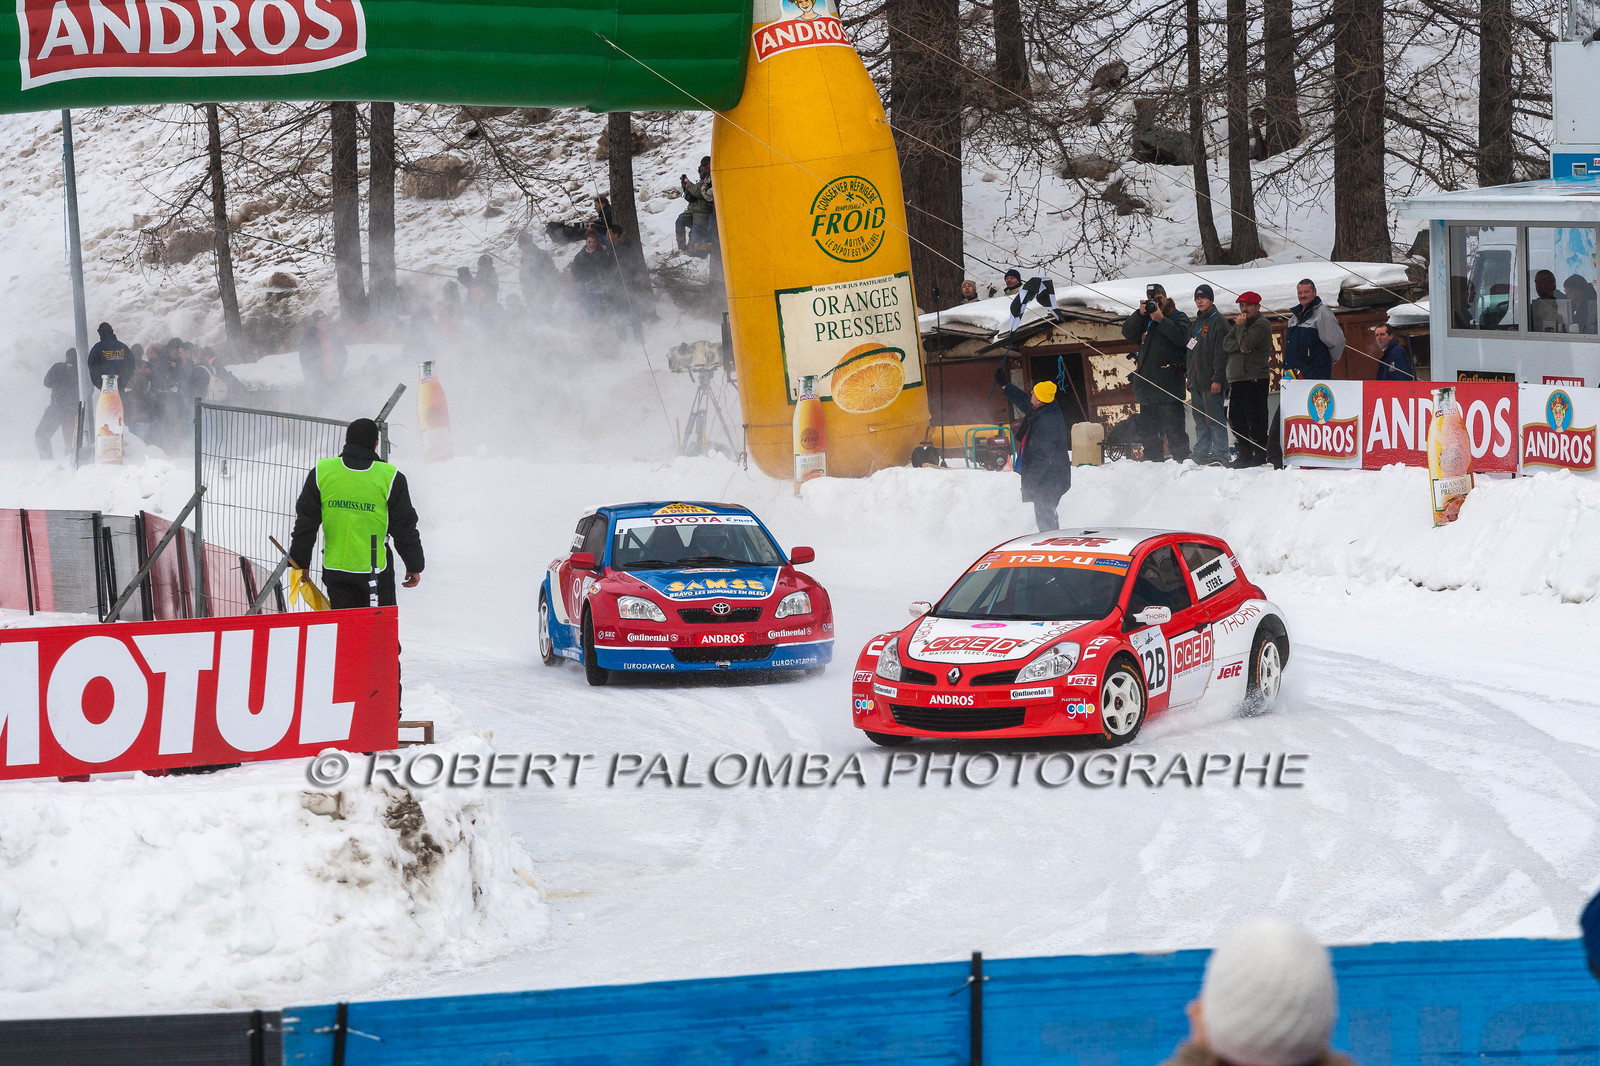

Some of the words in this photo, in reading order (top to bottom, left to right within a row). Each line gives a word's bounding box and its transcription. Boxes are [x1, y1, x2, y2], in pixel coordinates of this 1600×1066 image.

[37, 0, 344, 61] ANDROS
[761, 20, 849, 54] ANDROS
[817, 181, 849, 211] CONSERVER
[811, 206, 886, 237] FROID
[825, 238, 835, 248] LE
[851, 247, 862, 258] EST
[861, 232, 880, 254] NATUREL
[844, 235, 866, 248] AGITER
[812, 286, 900, 317] ORANGES
[814, 311, 902, 343] PRESSEES
[1286, 423, 1355, 454] ANDROS
[1366, 396, 1512, 459] ANDOS
[1524, 430, 1593, 465] ANDROS
[327, 499, 377, 513] COMMISSAIRE
[650, 516, 723, 525] TOYOTA
[1008, 554, 1094, 566] nav-u
[667, 578, 766, 592] SAMSE
[1144, 612, 1169, 620] THORN
[1220, 604, 1262, 635] THORN
[626, 632, 670, 643] Continental
[700, 633, 746, 645] ANDROS
[767, 627, 807, 640] Continental
[927, 637, 1020, 653] CGED
[1175, 635, 1212, 670] CGED
[623, 662, 676, 670] EURODATACAR
[929, 694, 976, 707] ANDROS
[1011, 688, 1047, 699] Continental
